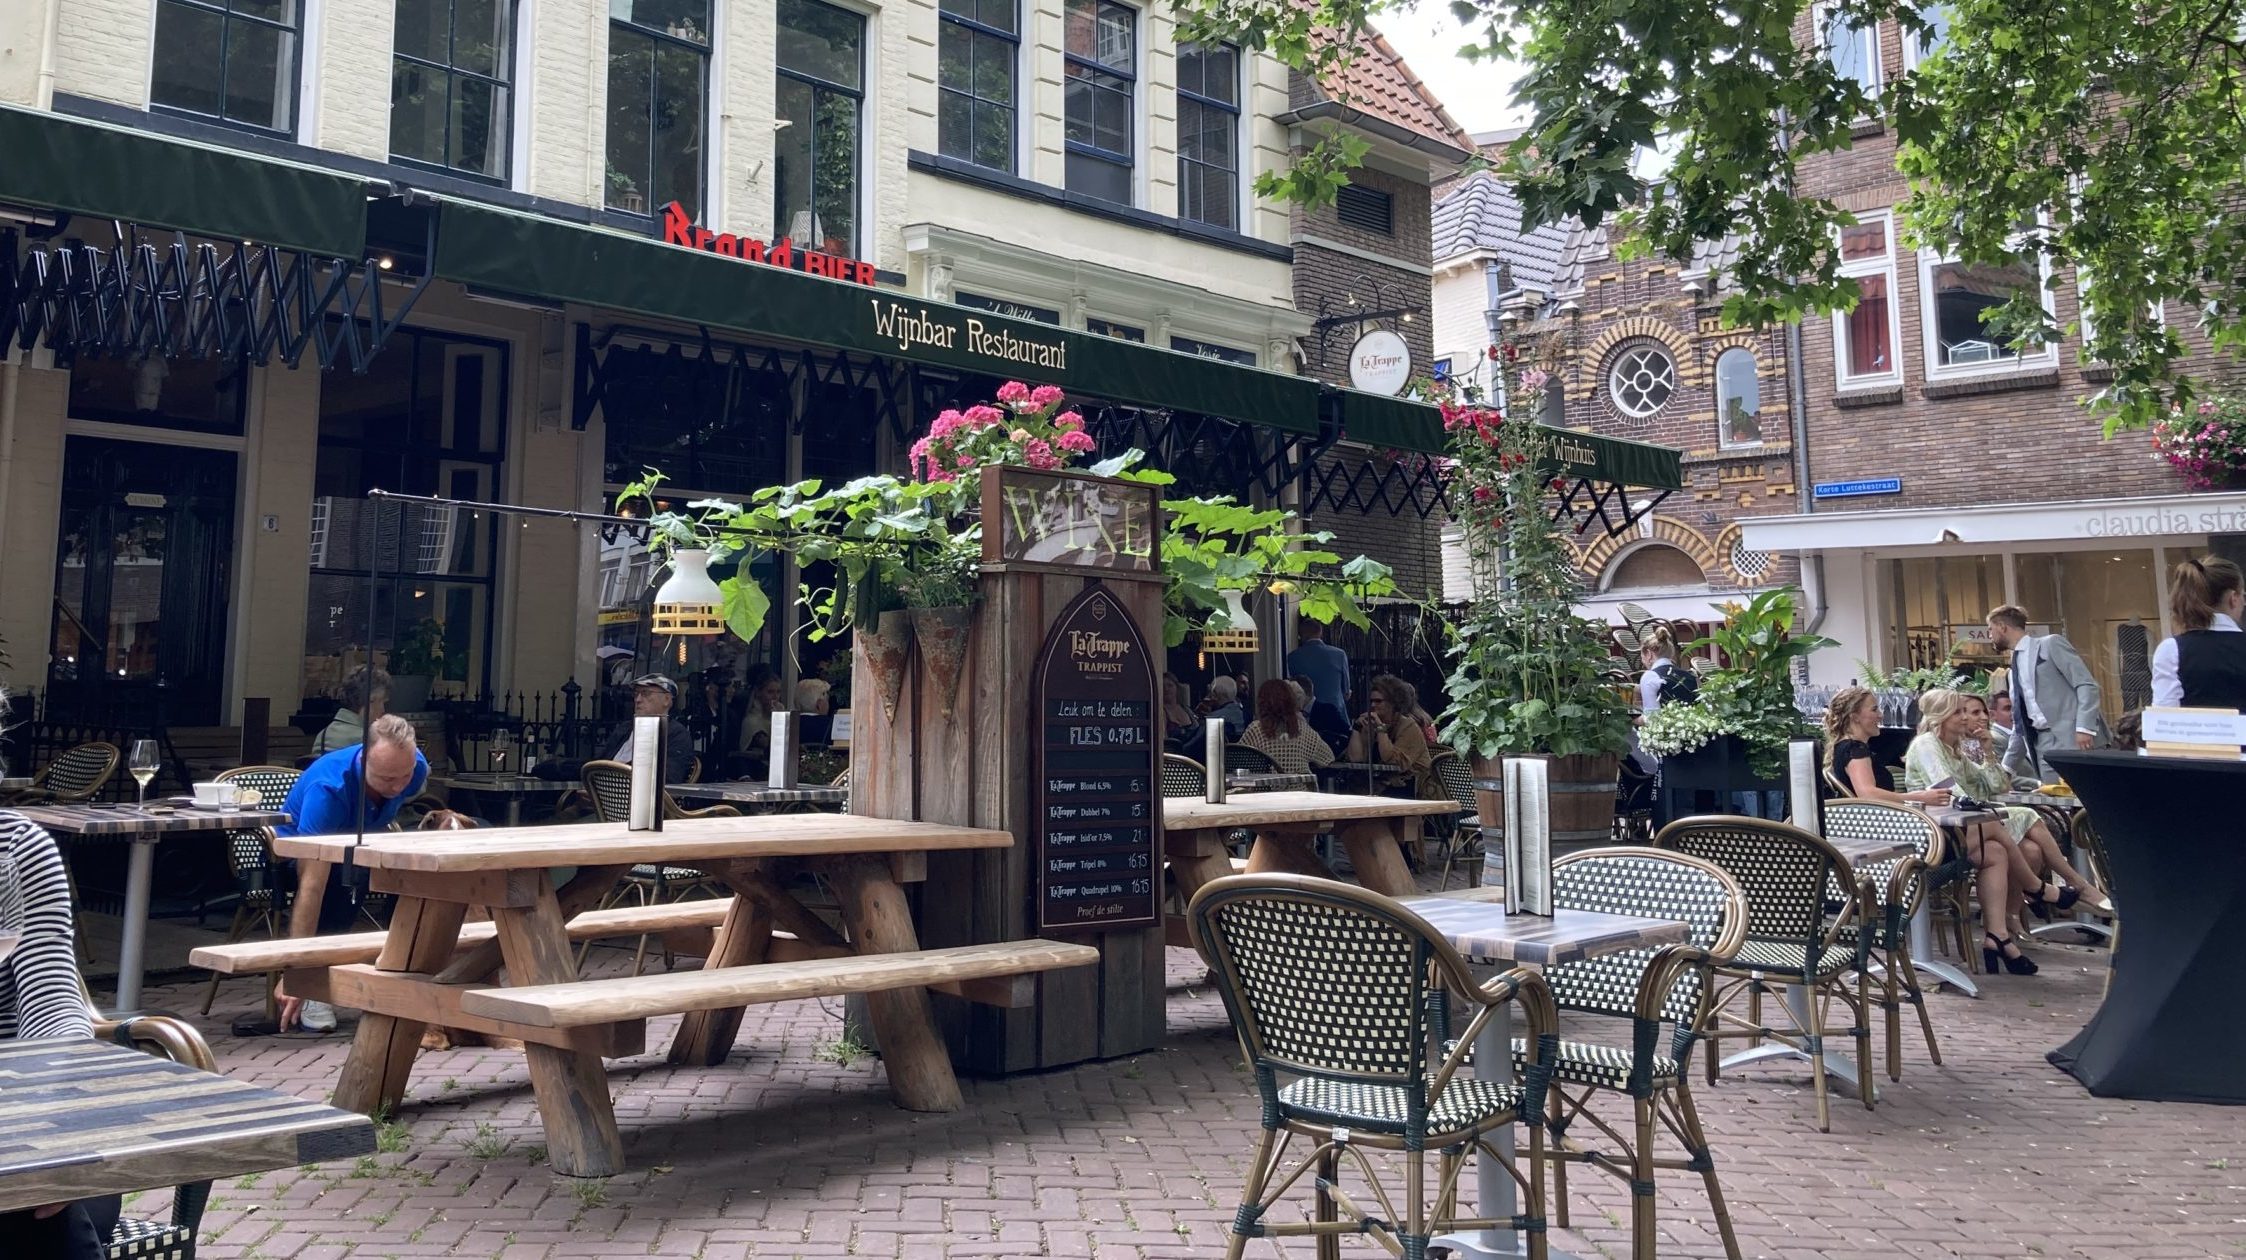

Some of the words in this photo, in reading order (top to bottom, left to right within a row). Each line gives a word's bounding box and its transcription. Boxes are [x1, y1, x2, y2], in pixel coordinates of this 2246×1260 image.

[661, 200, 793, 268] Brand
[804, 251, 876, 286] BIER
[871, 299, 956, 351] Wijnbar
[966, 318, 1067, 370] Restaurant
[1360, 356, 1370, 369] La
[1370, 354, 1403, 369] Trappe
[1552, 436, 1596, 469] Wijnhuis
[1003, 485, 1152, 558] WINE
[2086, 507, 2192, 536] claudia
[1068, 630, 1086, 660] La
[1085, 631, 1130, 659] Trappe
[1077, 661, 1124, 673] TRAPPIST
[1058, 700, 1079, 717] Leuk
[1082, 705, 1094, 717] om
[1098, 701, 1106, 717] te
[1070, 726, 1102, 745] FLES
[1057, 780, 1076, 792] Trappe
[1080, 782, 1097, 790] Blond
[1057, 806, 1076, 819] Trappe
[1080, 808, 1100, 817] Dubbel
[1101, 808, 1111, 816] 7%
[1057, 833, 1076, 845] Trappe
[1057, 859, 1076, 872] Trappe
[1081, 860, 1096, 871] Tripel
[1057, 886, 1076, 898] Trappe
[1081, 885, 1109, 896] Quadrupel
[1077, 904, 1096, 918] Proef
[1097, 904, 1105, 915] de
